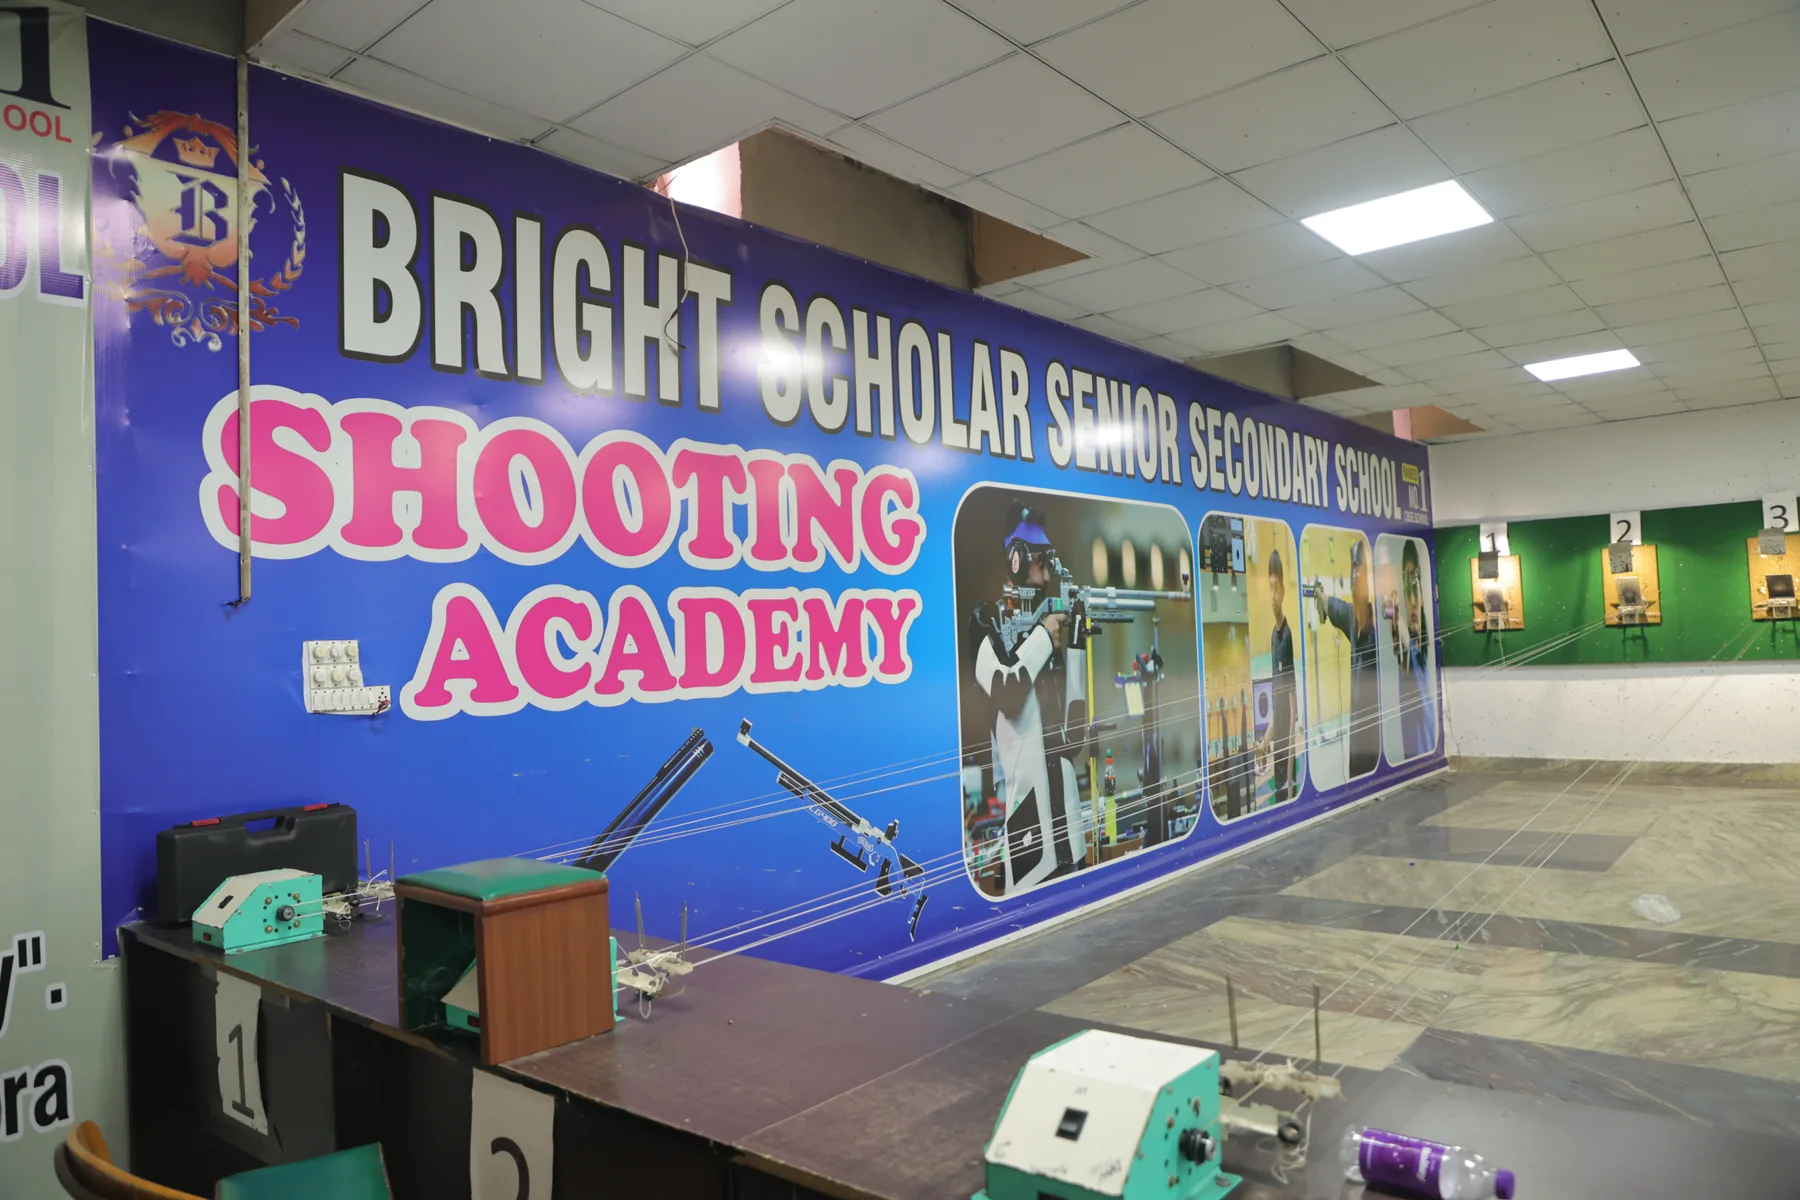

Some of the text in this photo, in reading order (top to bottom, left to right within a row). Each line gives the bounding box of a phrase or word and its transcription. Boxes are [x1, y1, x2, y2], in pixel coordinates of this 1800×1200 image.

[340, 168, 1402, 519] BRIGHT SCHOLAR SENIOR SECONDARY SCHOOL
[208, 391, 923, 571] SHOOTING
[1770, 504, 1789, 530] 3
[1486, 532, 1501, 553] 1
[1616, 520, 1633, 543] 2
[407, 588, 919, 714] ACADEMY
[0, 1065, 69, 1136] ra
[229, 1022, 254, 1119] 1
